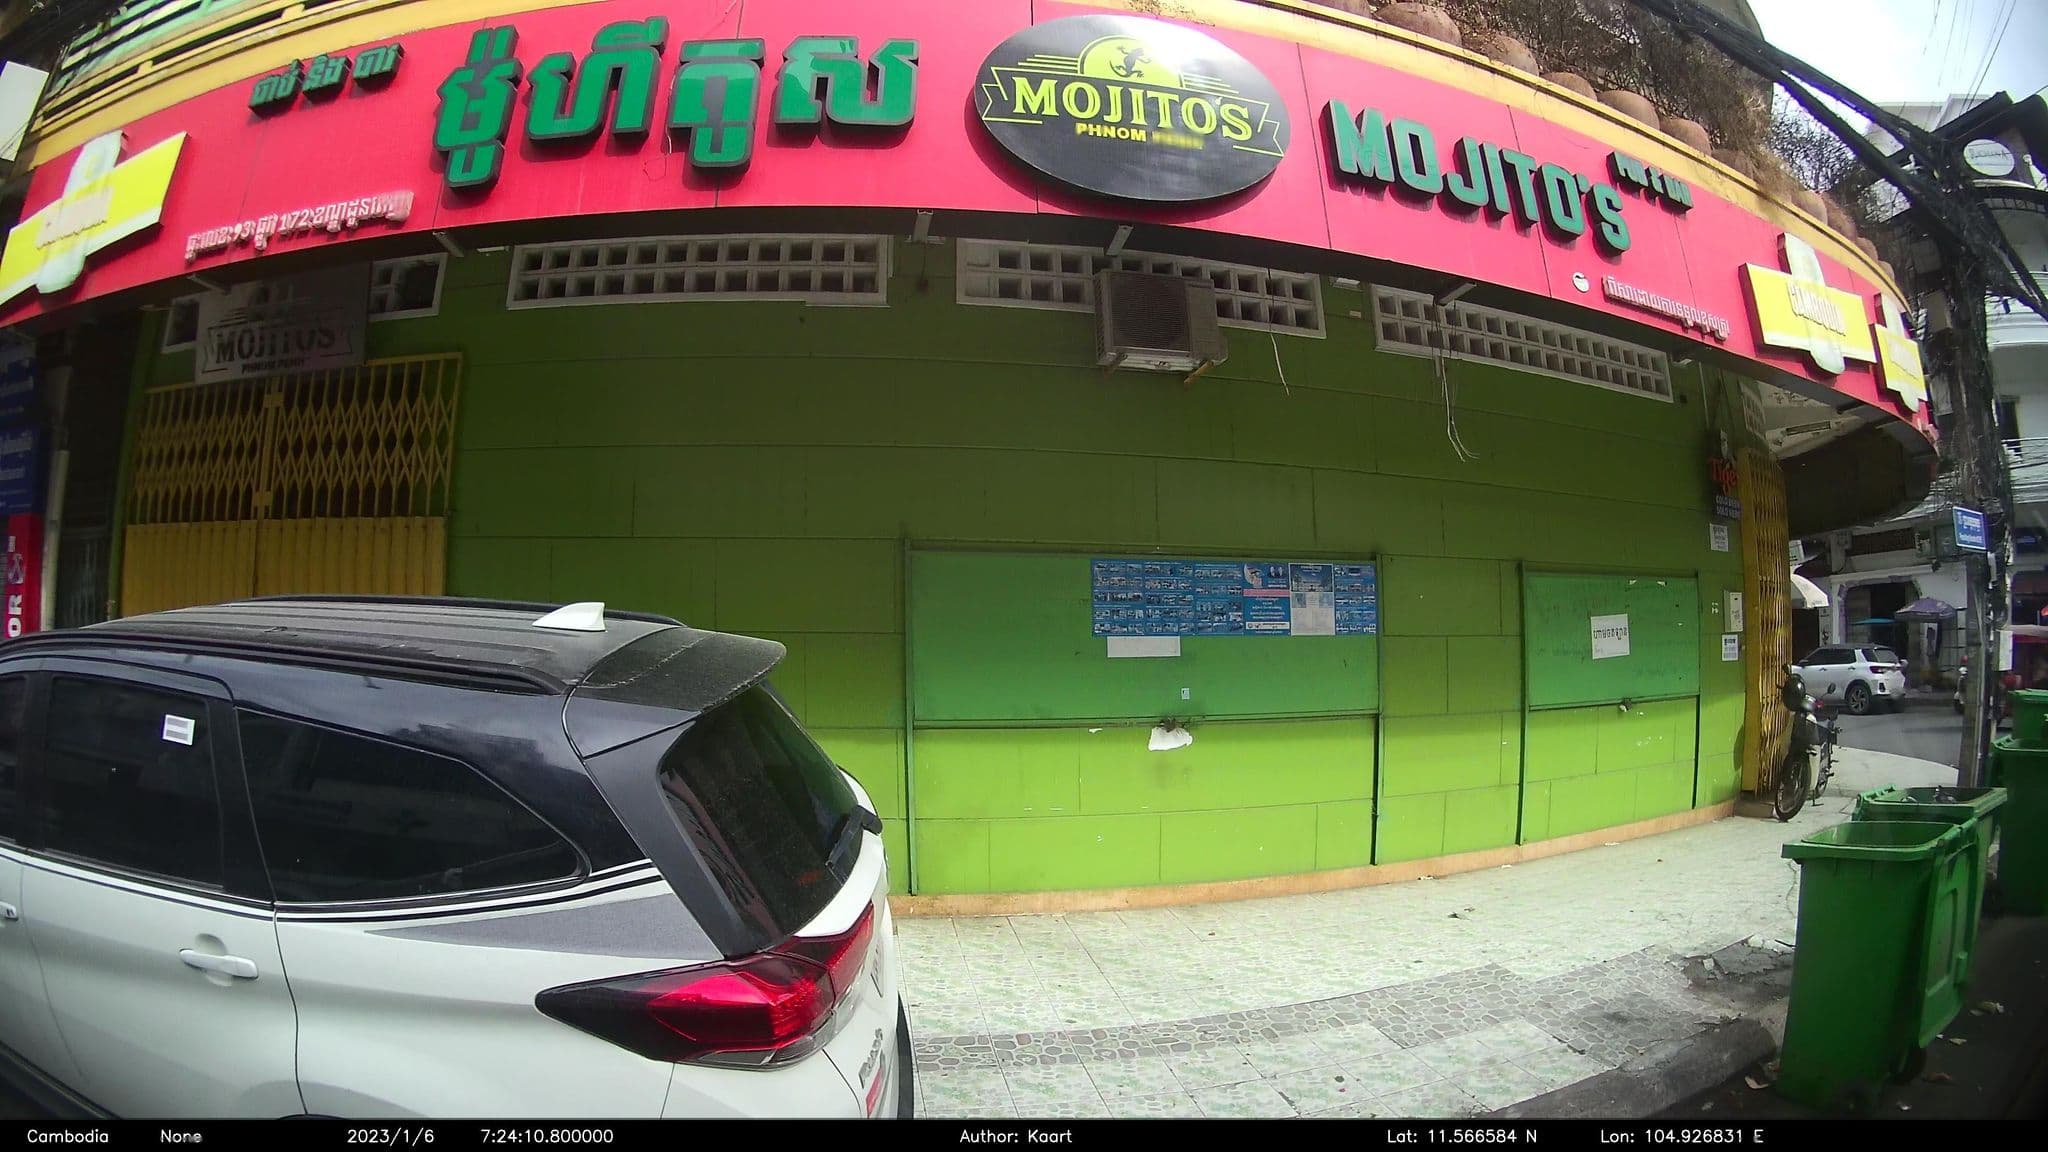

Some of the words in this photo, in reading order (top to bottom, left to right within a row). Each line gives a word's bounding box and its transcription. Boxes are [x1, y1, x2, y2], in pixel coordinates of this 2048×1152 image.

[1076, 122, 1148, 142] PHNOM
[1322, 98, 1632, 254] MOJITO'S
[278, 209, 311, 236] 172
